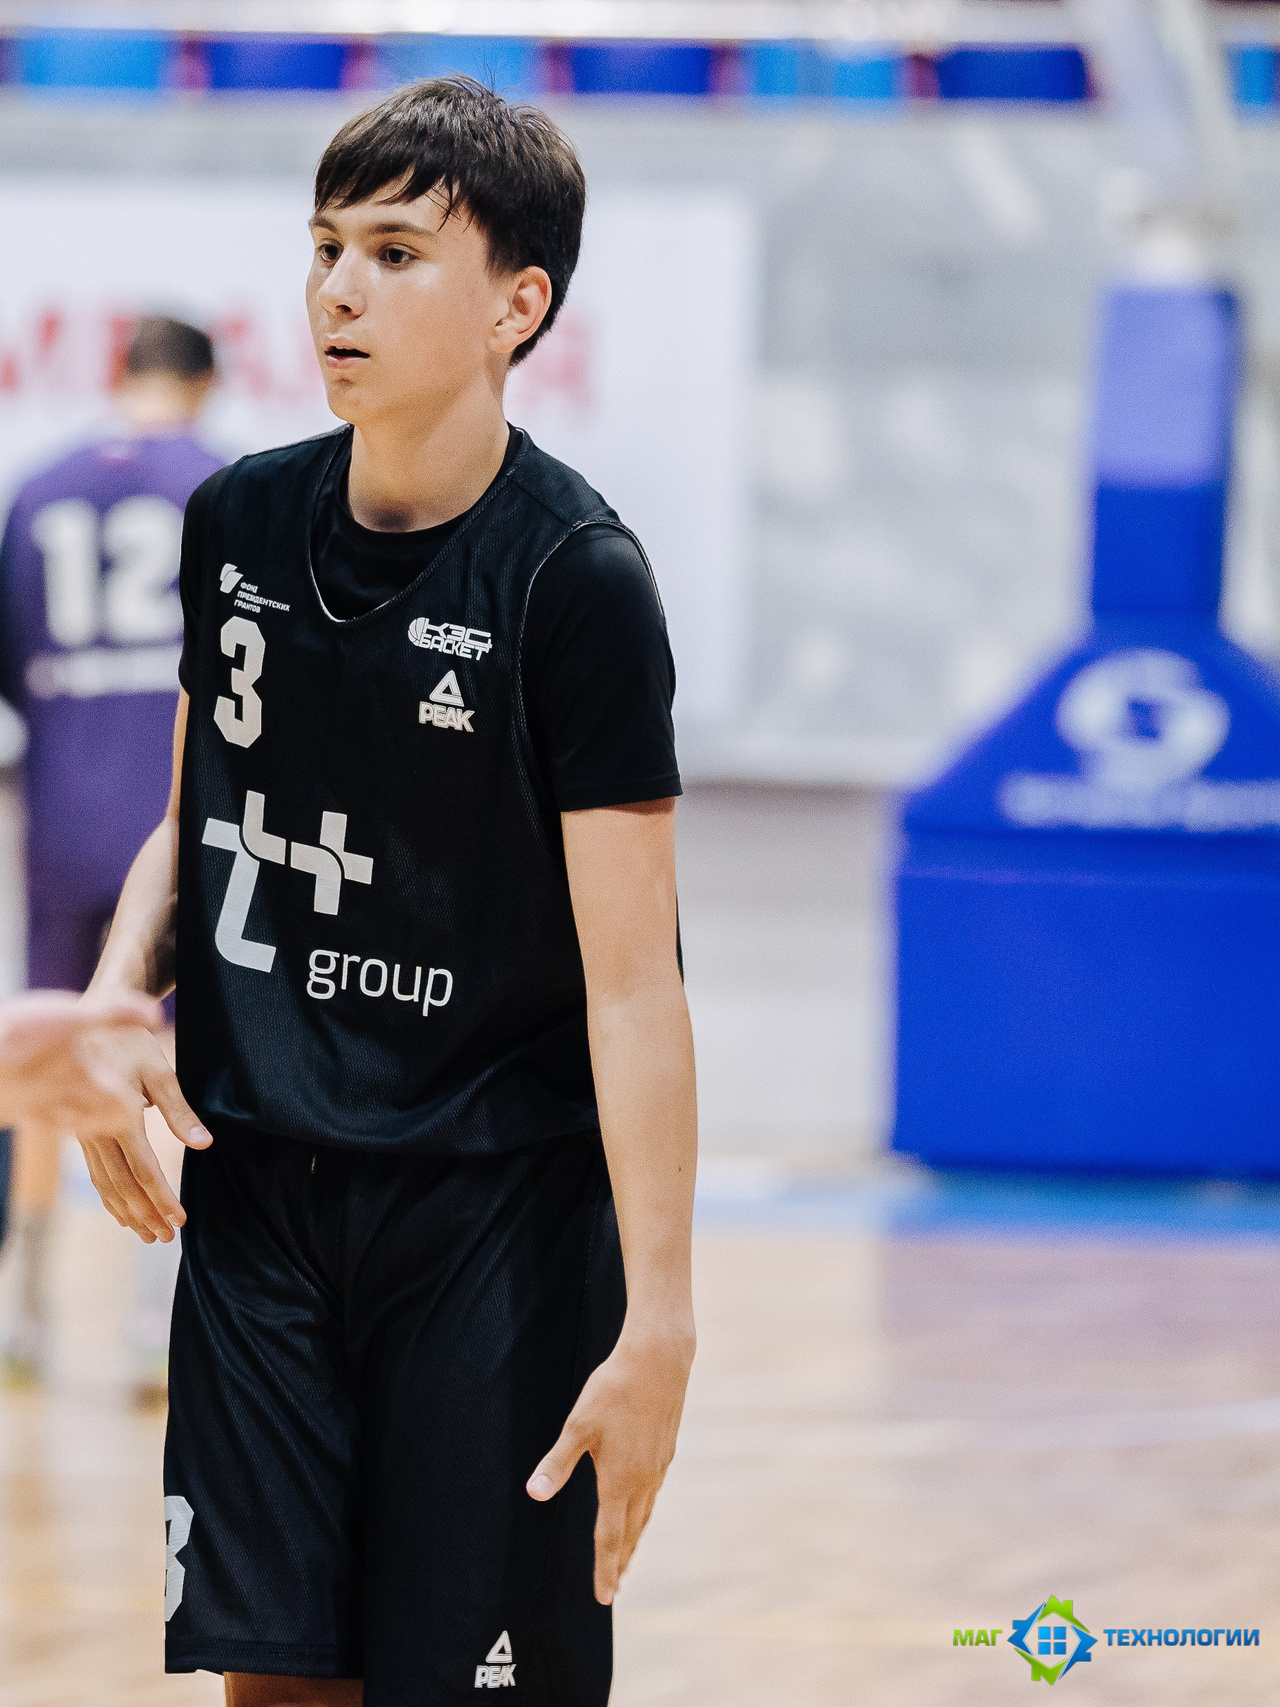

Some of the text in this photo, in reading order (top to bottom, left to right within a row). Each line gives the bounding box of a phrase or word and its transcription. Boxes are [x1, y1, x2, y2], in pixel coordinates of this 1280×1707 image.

[30, 495, 183, 648] 12
[233, 599, 262, 614] ГРАНТОВ
[213, 615, 266, 749] 3
[418, 700, 476, 733] PEAK
[306, 948, 454, 1018] group
[473, 1663, 517, 1689] PEAK
